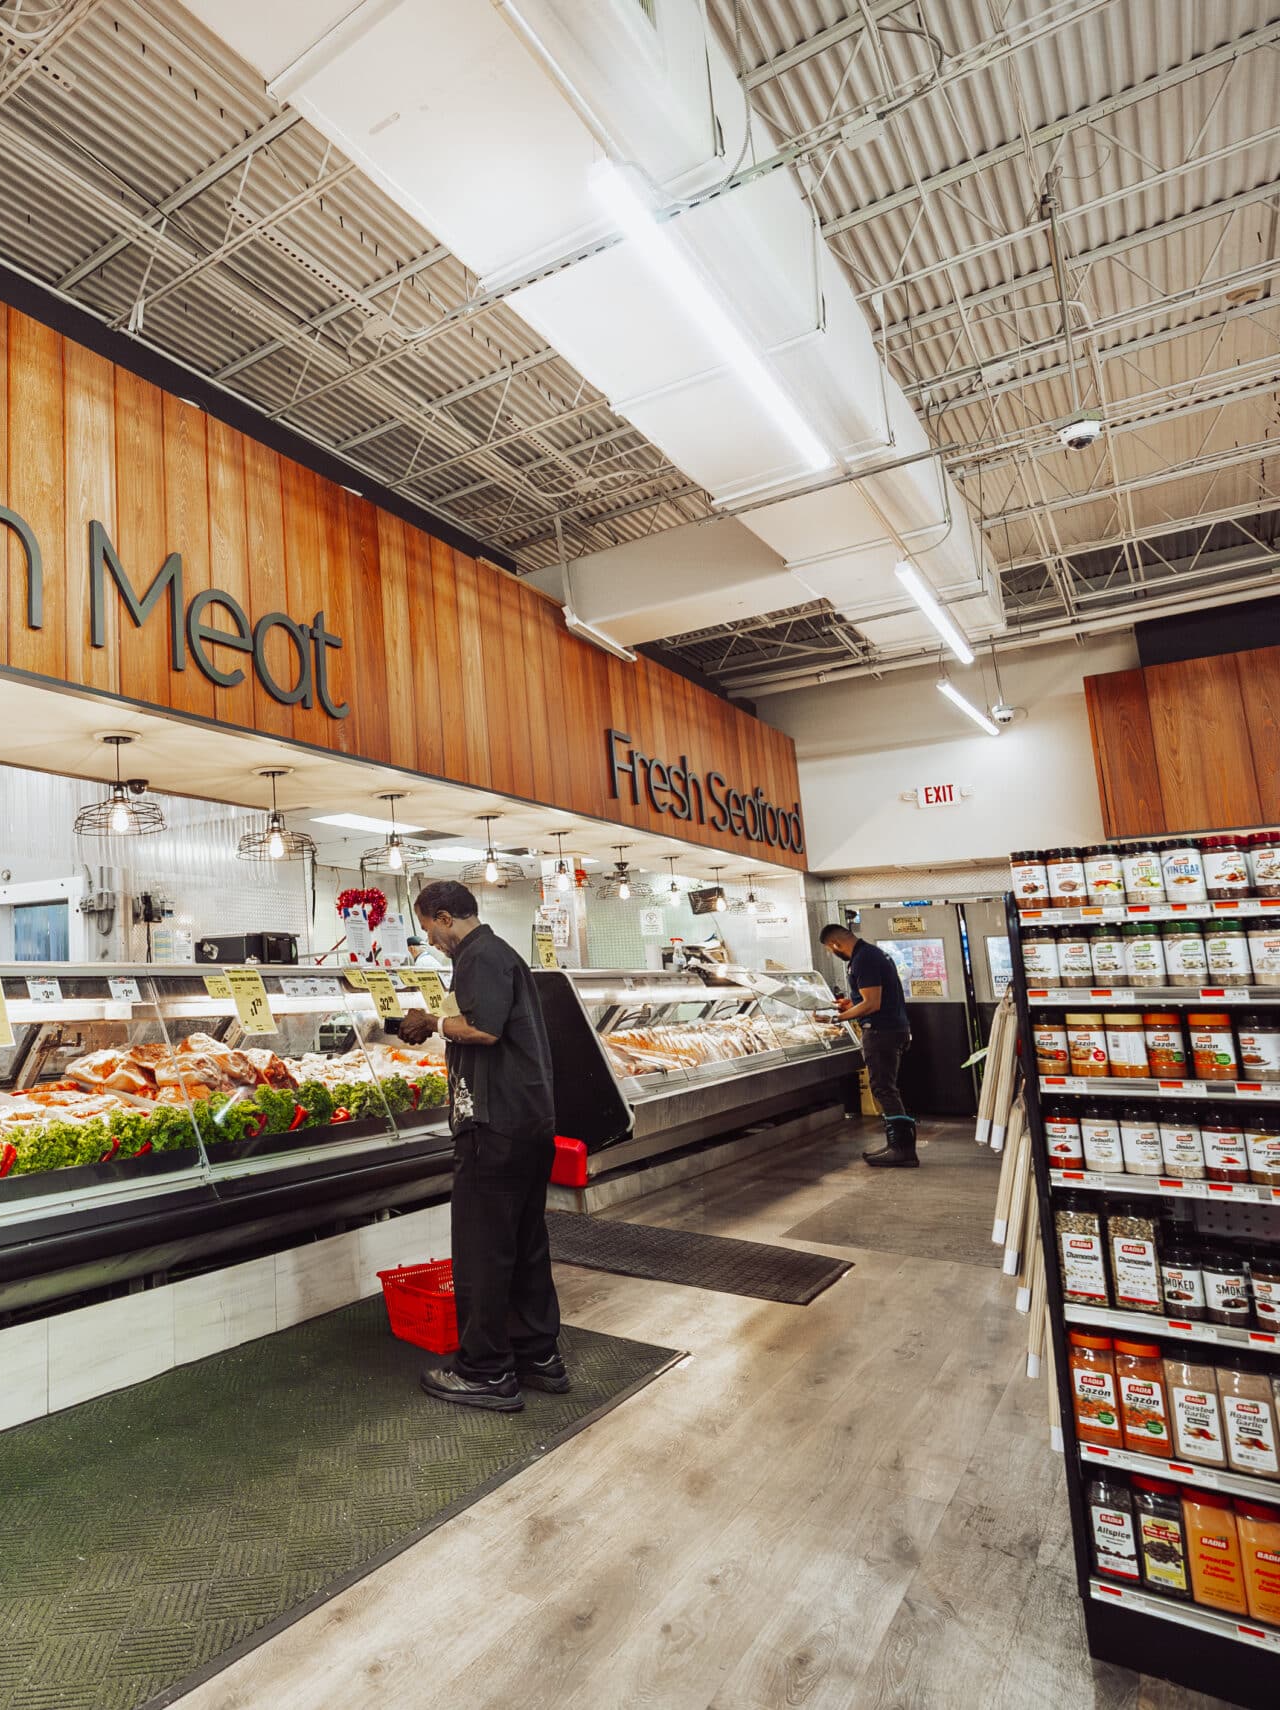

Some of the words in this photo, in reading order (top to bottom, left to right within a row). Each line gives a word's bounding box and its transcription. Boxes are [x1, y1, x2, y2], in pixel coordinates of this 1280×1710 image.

[89, 519, 350, 719] Meat
[607, 728, 705, 824] Fresh
[707, 771, 803, 853] Seafood
[924, 784, 954, 804] EXIT
[1166, 864, 1199, 875] VINEGAR
[1079, 1385, 1111, 1397] Sazón
[1126, 1394, 1160, 1406] Sazón
[1179, 1402, 1214, 1414] Roasted
[1230, 1411, 1268, 1423] Roasted
[1097, 1526, 1131, 1540] Allspice
[1201, 1537, 1227, 1549] BADIA
